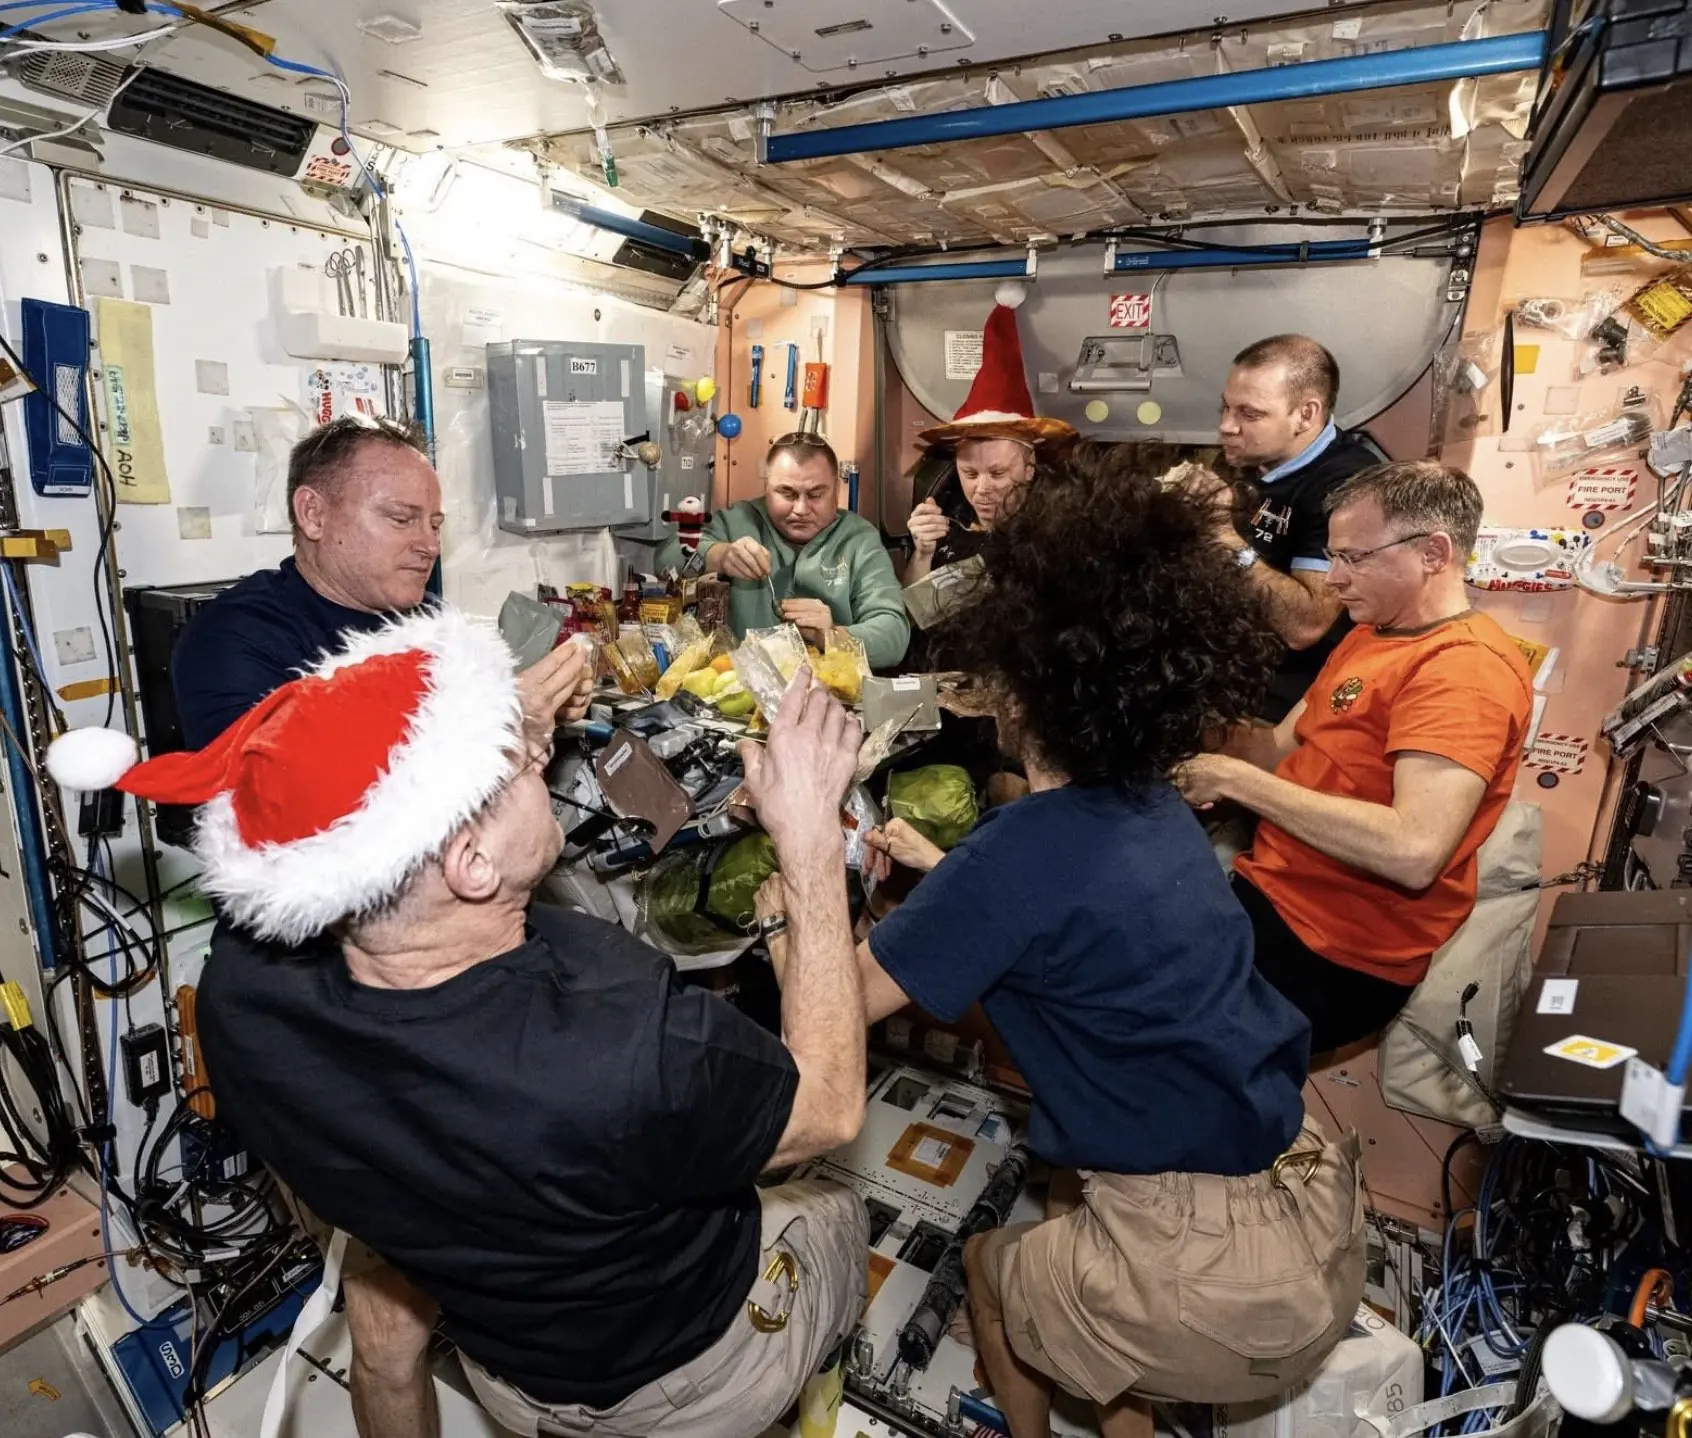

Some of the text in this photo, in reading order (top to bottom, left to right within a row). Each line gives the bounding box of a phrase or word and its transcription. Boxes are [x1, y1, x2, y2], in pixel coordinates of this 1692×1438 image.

[1116, 302, 1143, 320] EXIT
[572, 361, 596, 372] B677
[116, 449, 137, 487] AOH
[1601, 486, 1627, 494] PORT
[1255, 528, 1273, 543] 72
[1532, 747, 1577, 759] FIRE PORT
